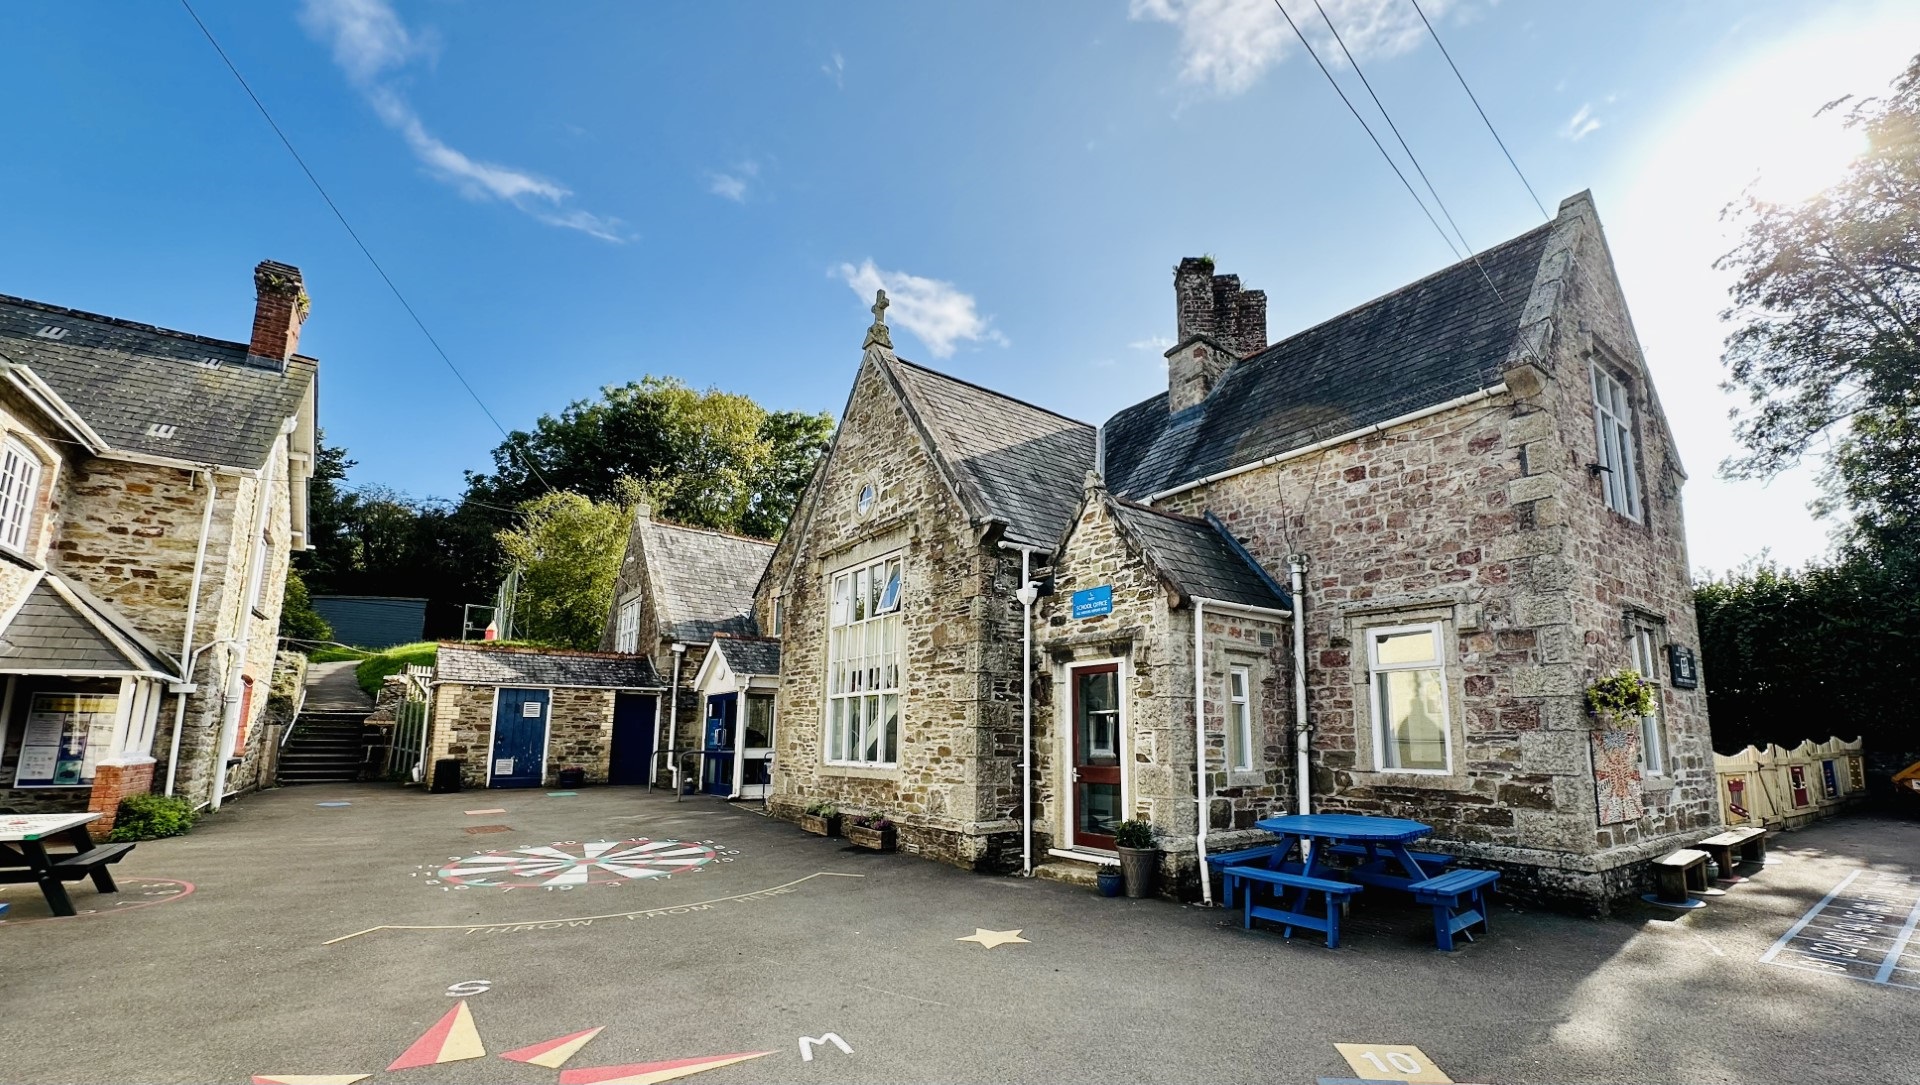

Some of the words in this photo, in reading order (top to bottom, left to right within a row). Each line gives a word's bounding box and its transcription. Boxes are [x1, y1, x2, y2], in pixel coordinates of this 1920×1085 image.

[1076, 603, 1092, 611] SCHOOL
[465, 919, 594, 935] THROW
[627, 904, 714, 920] FROM
[734, 888, 798, 904] HERE
[1823, 932, 1869, 944] 93
[1810, 942, 1858, 957] 92
[1798, 955, 1847, 971] 91
[445, 980, 492, 996] S
[1360, 1052, 1422, 1074] 10
